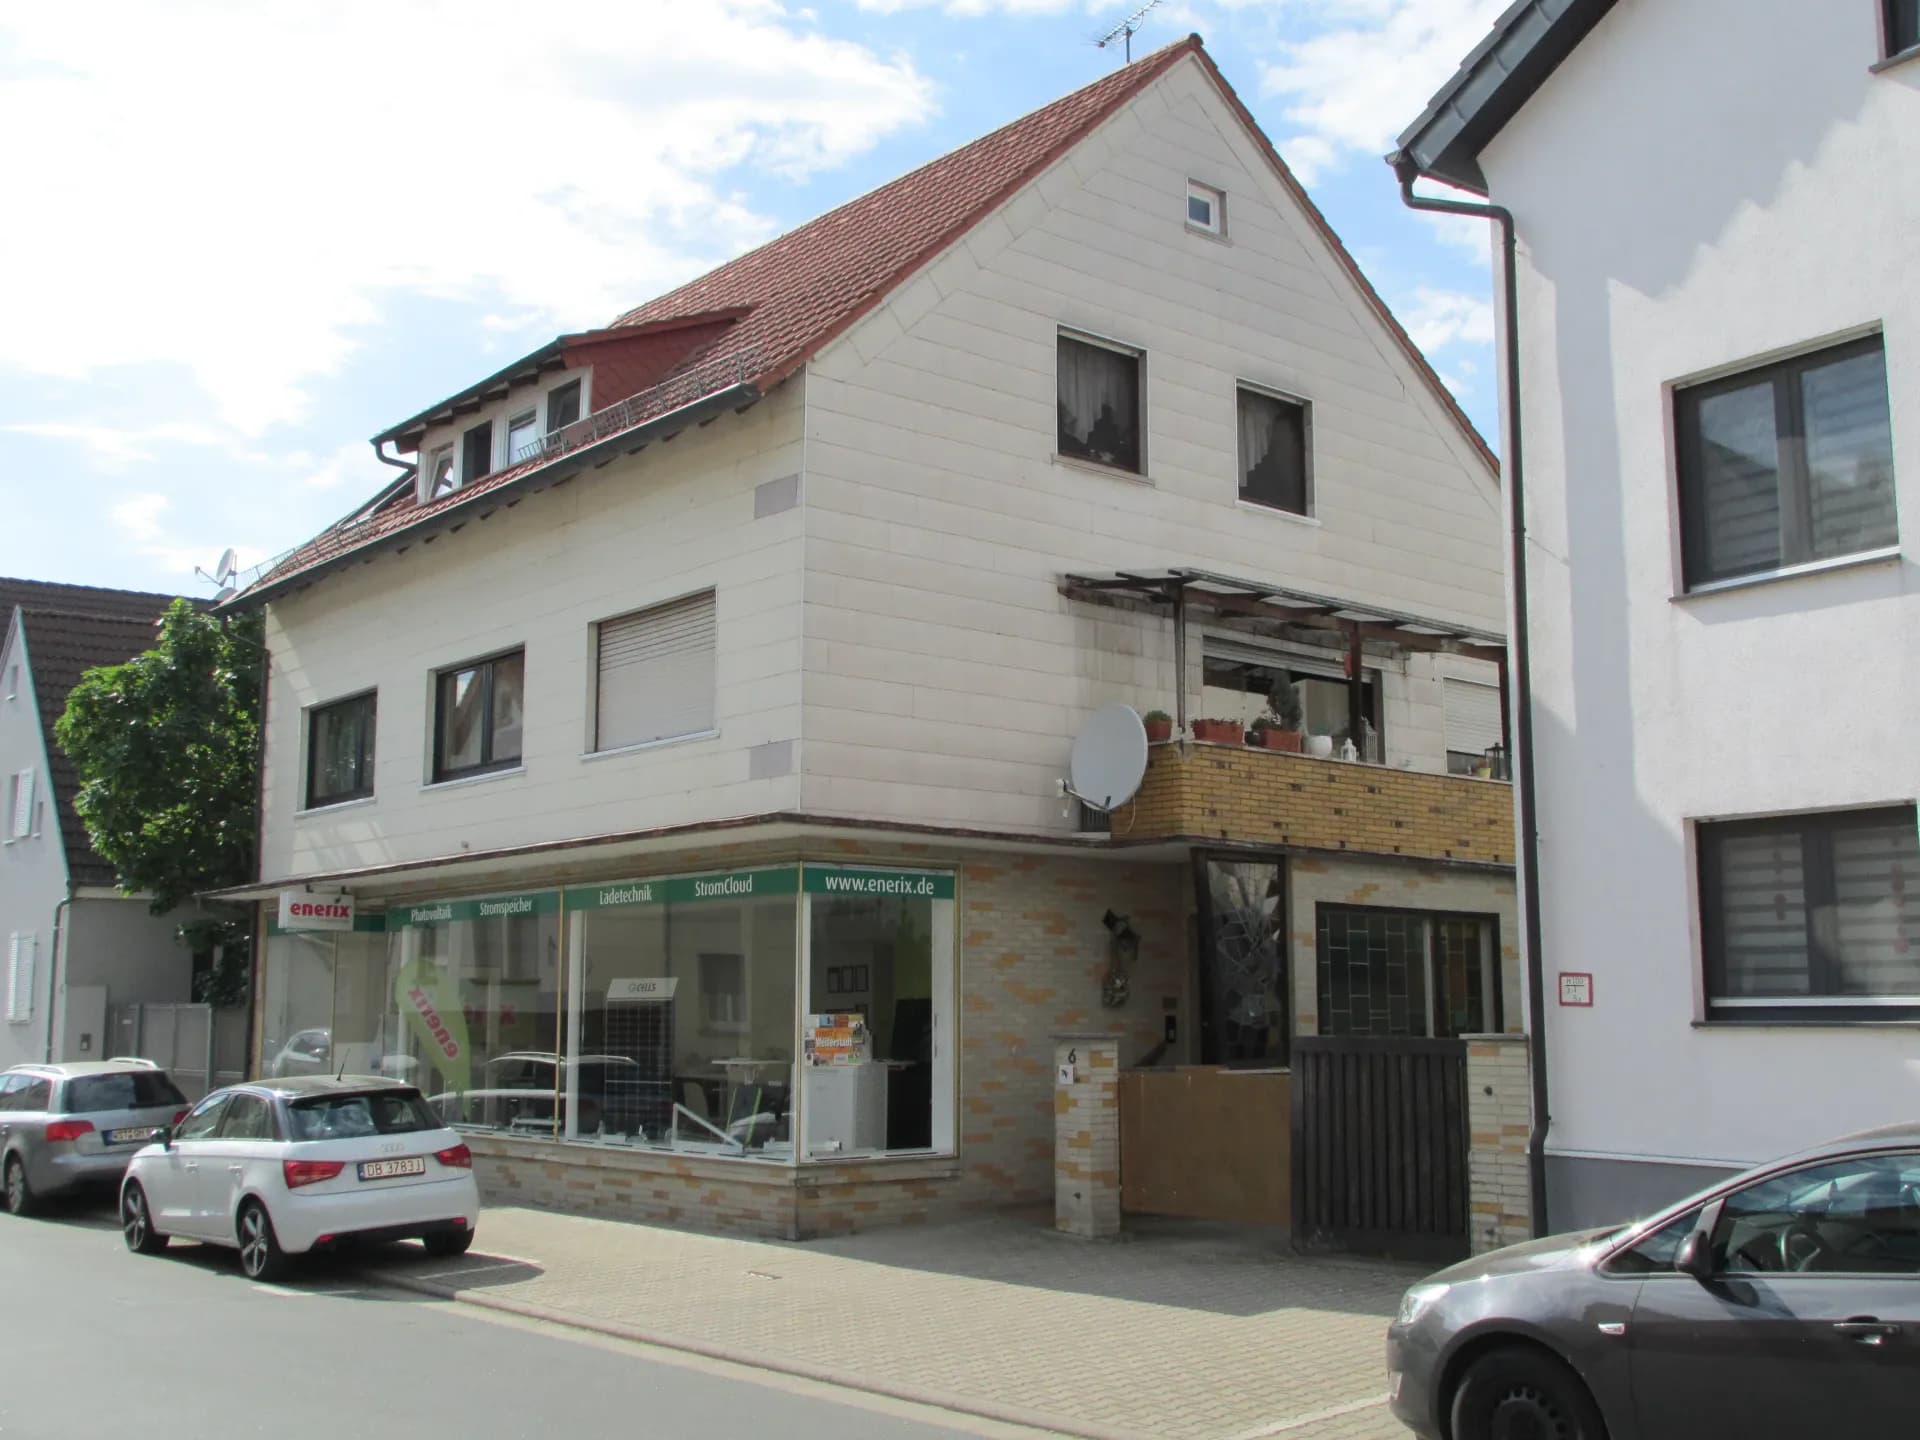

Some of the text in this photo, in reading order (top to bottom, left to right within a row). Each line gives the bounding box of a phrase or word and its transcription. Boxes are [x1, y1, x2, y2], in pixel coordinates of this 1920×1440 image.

[599, 884, 652, 905] Ladetechnik
[695, 875, 753, 897] StromCloud
[825, 876, 934, 895] www.enerix.de
[290, 903, 350, 918] enerix
[411, 904, 452, 921] Photovoltaik
[479, 897, 533, 917] Stromspeicher
[407, 988, 458, 1058] enerix
[1067, 1047, 1077, 1065] 6
[367, 1163, 383, 1177] DB
